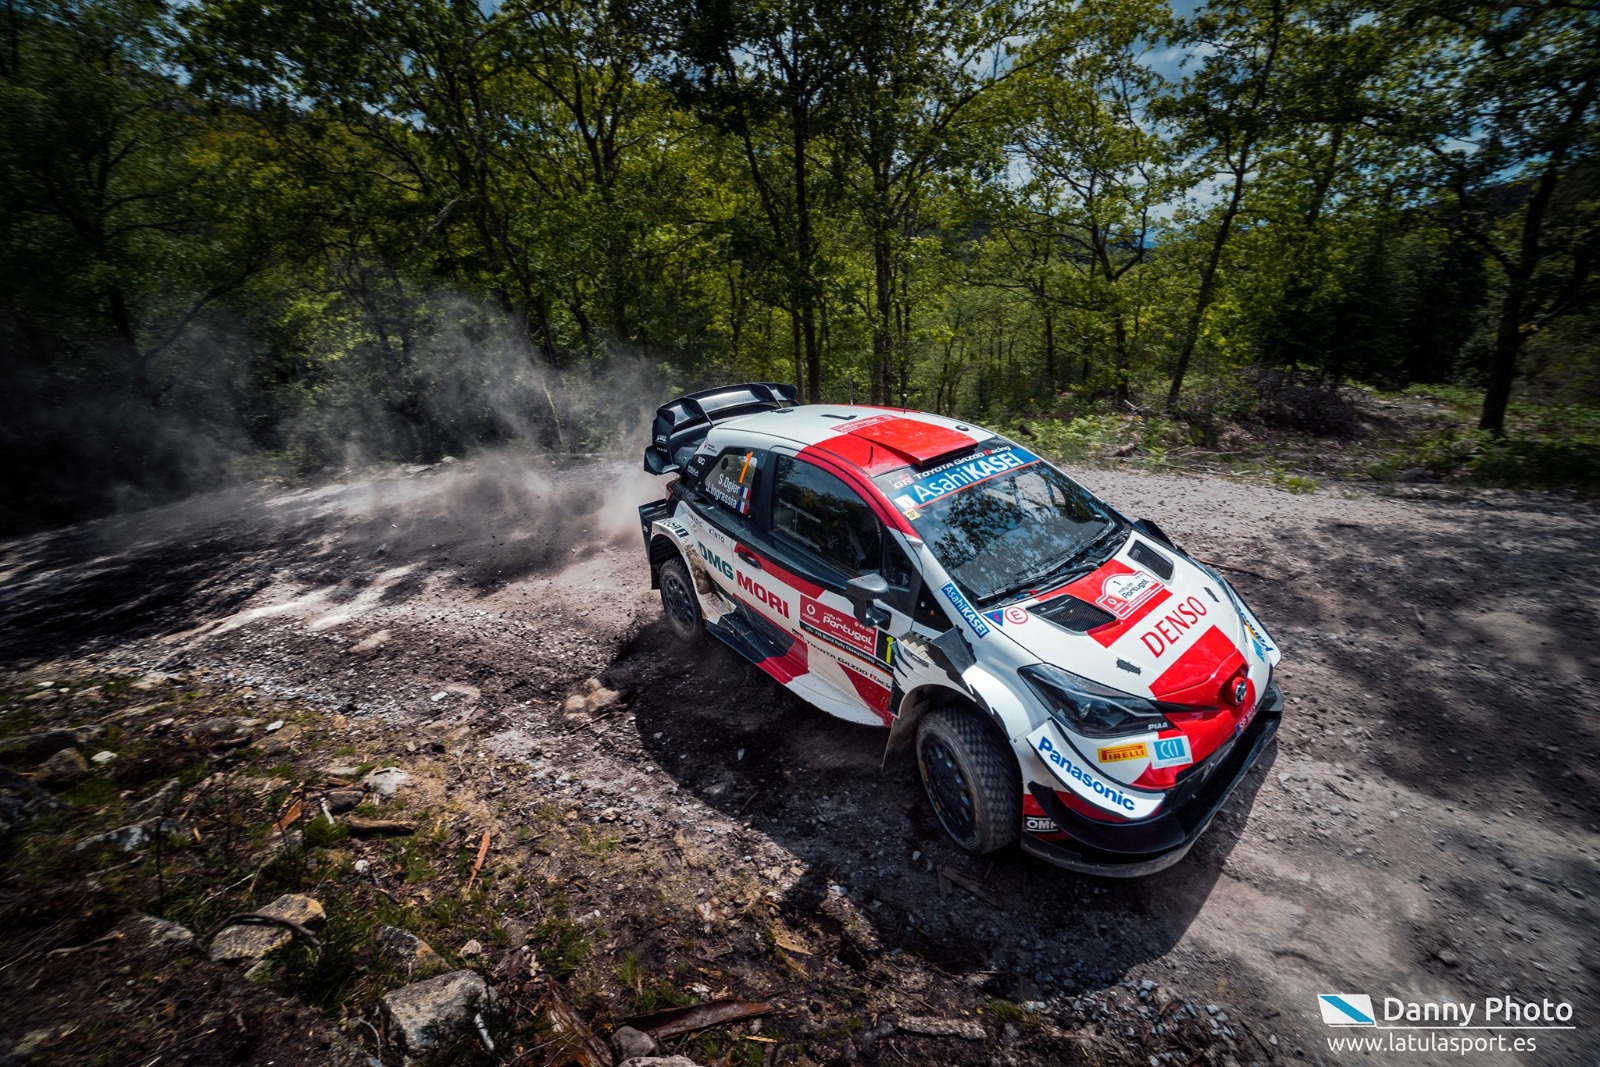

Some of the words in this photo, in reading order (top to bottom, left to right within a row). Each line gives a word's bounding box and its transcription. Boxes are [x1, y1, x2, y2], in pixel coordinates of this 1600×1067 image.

[738, 451, 754, 484] 1
[913, 452, 1025, 503] AsahiKASEI
[914, 462, 954, 480] TOYOTA
[954, 453, 984, 466] GAZOO
[983, 445, 1012, 456] Racing
[718, 474, 741, 495] S.Ogier
[698, 541, 734, 581] DMG
[736, 569, 790, 620] MORI
[1122, 578, 1149, 599] Portugal
[944, 586, 988, 637] AsahiKASEI
[1010, 610, 1023, 620] E
[1140, 596, 1208, 659] DENSO
[822, 615, 873, 646] Portugal
[837, 657, 868, 676] GAZOO
[1147, 722, 1169, 731] PIAA
[1101, 745, 1146, 761] PIRELLI
[1038, 736, 1136, 811] Panasonic
